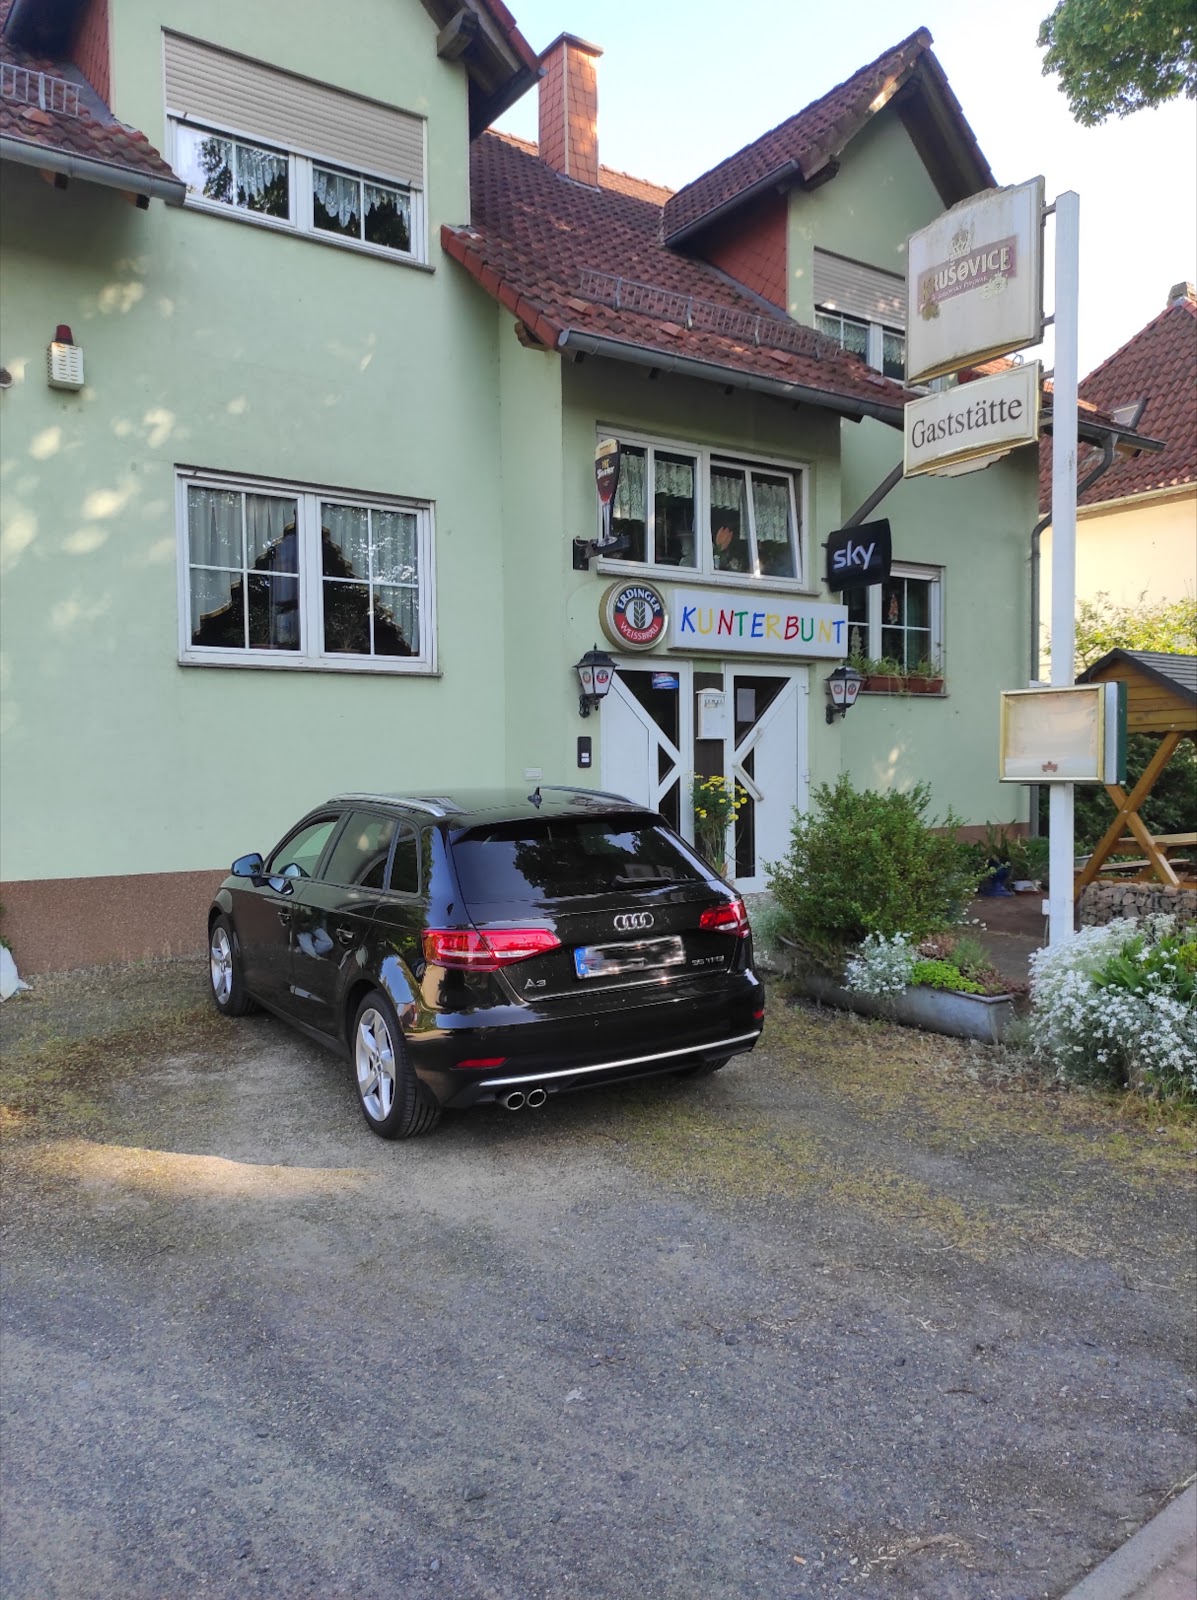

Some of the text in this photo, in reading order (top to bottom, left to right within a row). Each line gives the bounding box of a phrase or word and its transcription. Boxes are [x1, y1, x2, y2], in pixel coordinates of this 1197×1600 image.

[911, 398, 1023, 449] Gaststätte
[833, 540, 876, 571] sky
[616, 588, 660, 612] ERDINGER
[680, 606, 846, 644] KUNTERBUNT
[523, 978, 546, 990] A3
